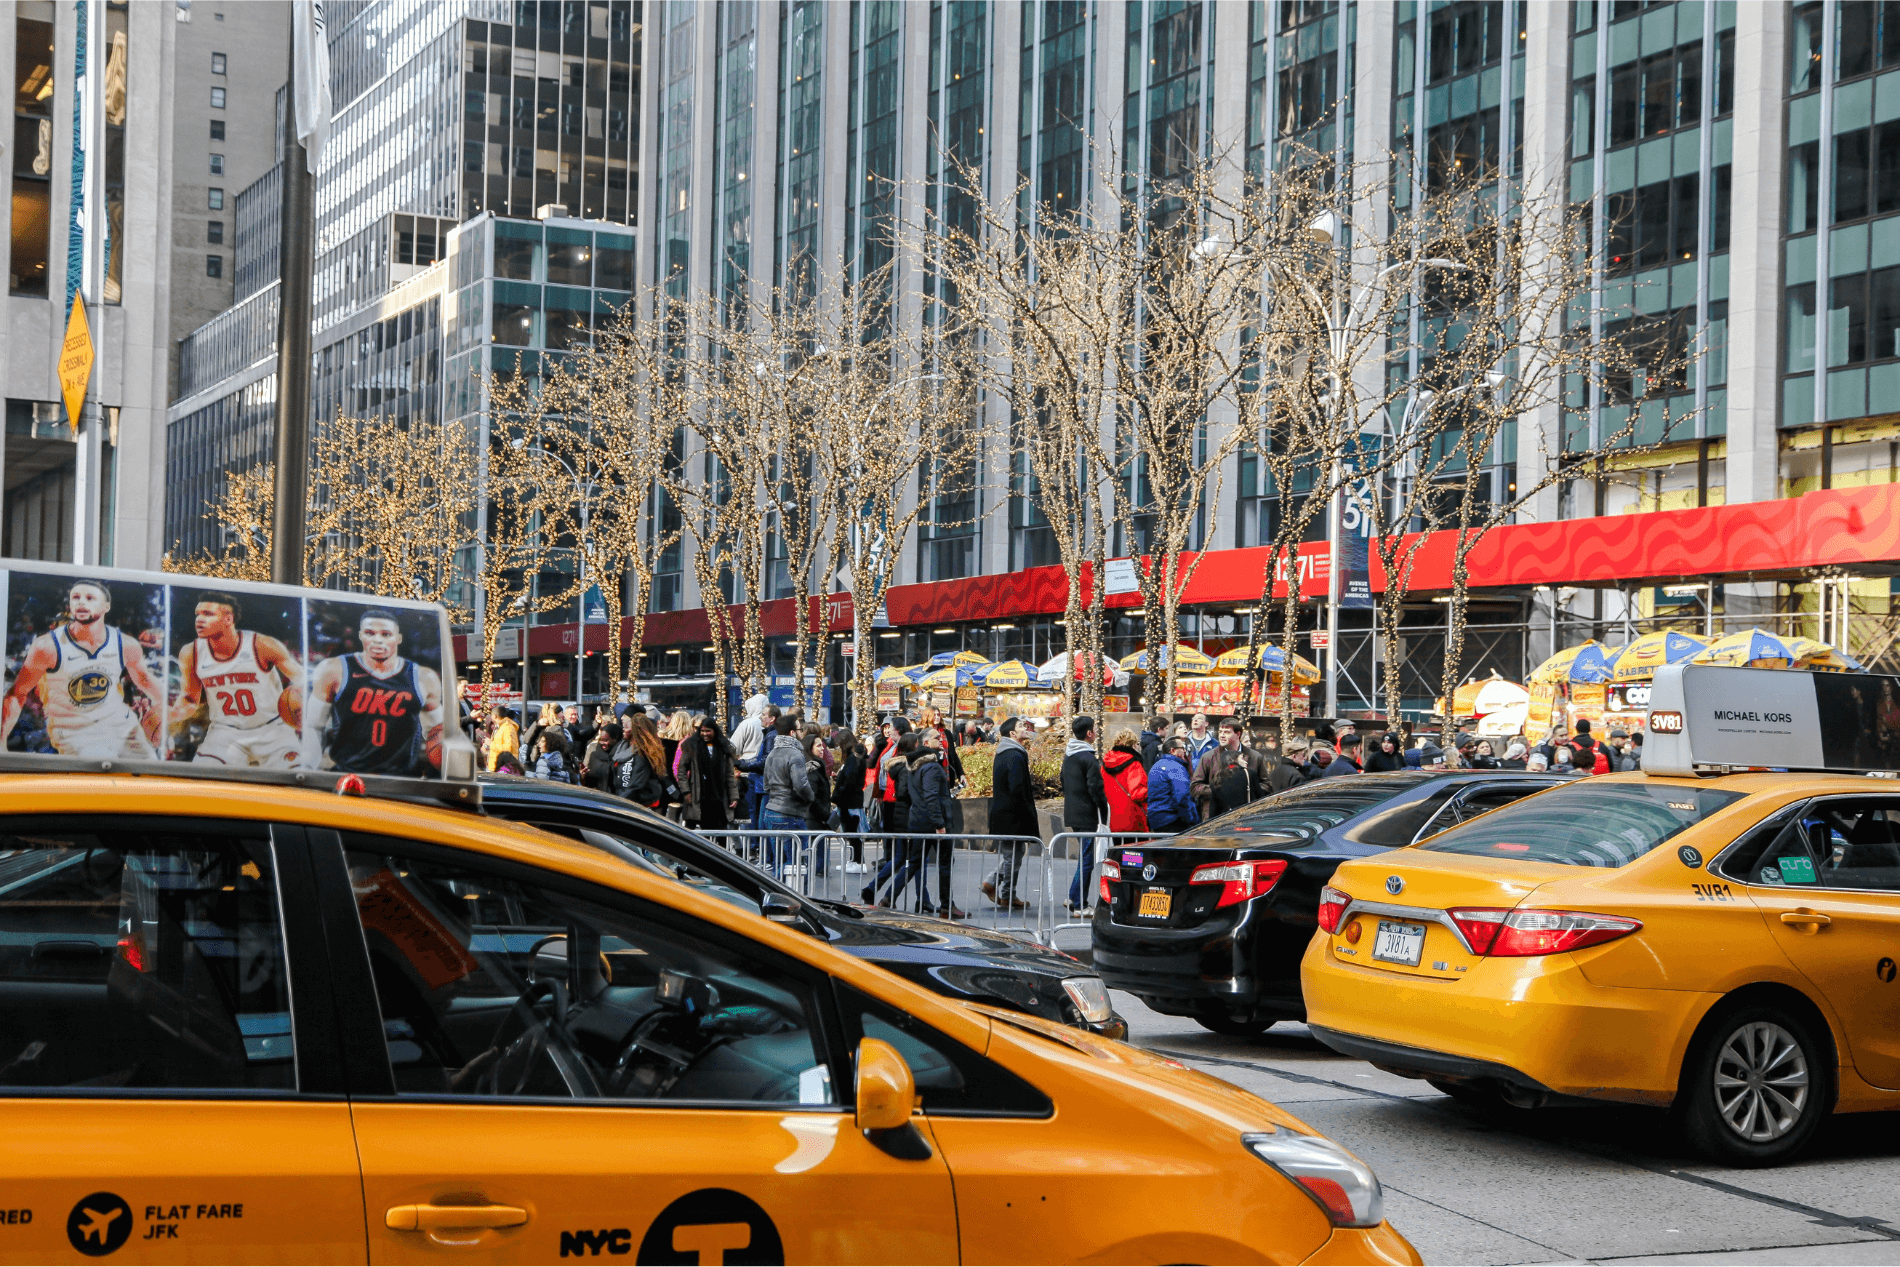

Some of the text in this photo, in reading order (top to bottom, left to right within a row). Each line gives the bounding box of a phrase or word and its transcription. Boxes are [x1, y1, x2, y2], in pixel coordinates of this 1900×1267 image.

[826, 602, 841, 624] 271
[1176, 662, 1209, 670] ABRETT
[1222, 658, 1248, 666] SABRE
[1618, 666, 1656, 677] SABRET
[89, 677, 108, 688] 30
[202, 672, 259, 688] NEW YORK
[988, 677, 1026, 685] SABRETT
[216, 688, 257, 716] 20
[351, 687, 412, 717] OKC
[1651, 714, 1682, 730] 3V81
[1714, 710, 1792, 723] MICHAEL KORS
[371, 719, 387, 747] 0
[1780, 857, 1813, 870] curb
[1691, 883, 1735, 901] 3V81
[145, 1203, 243, 1220] FLAT FARE
[143, 1224, 179, 1240] JFK
[560, 1228, 632, 1258] NYC
